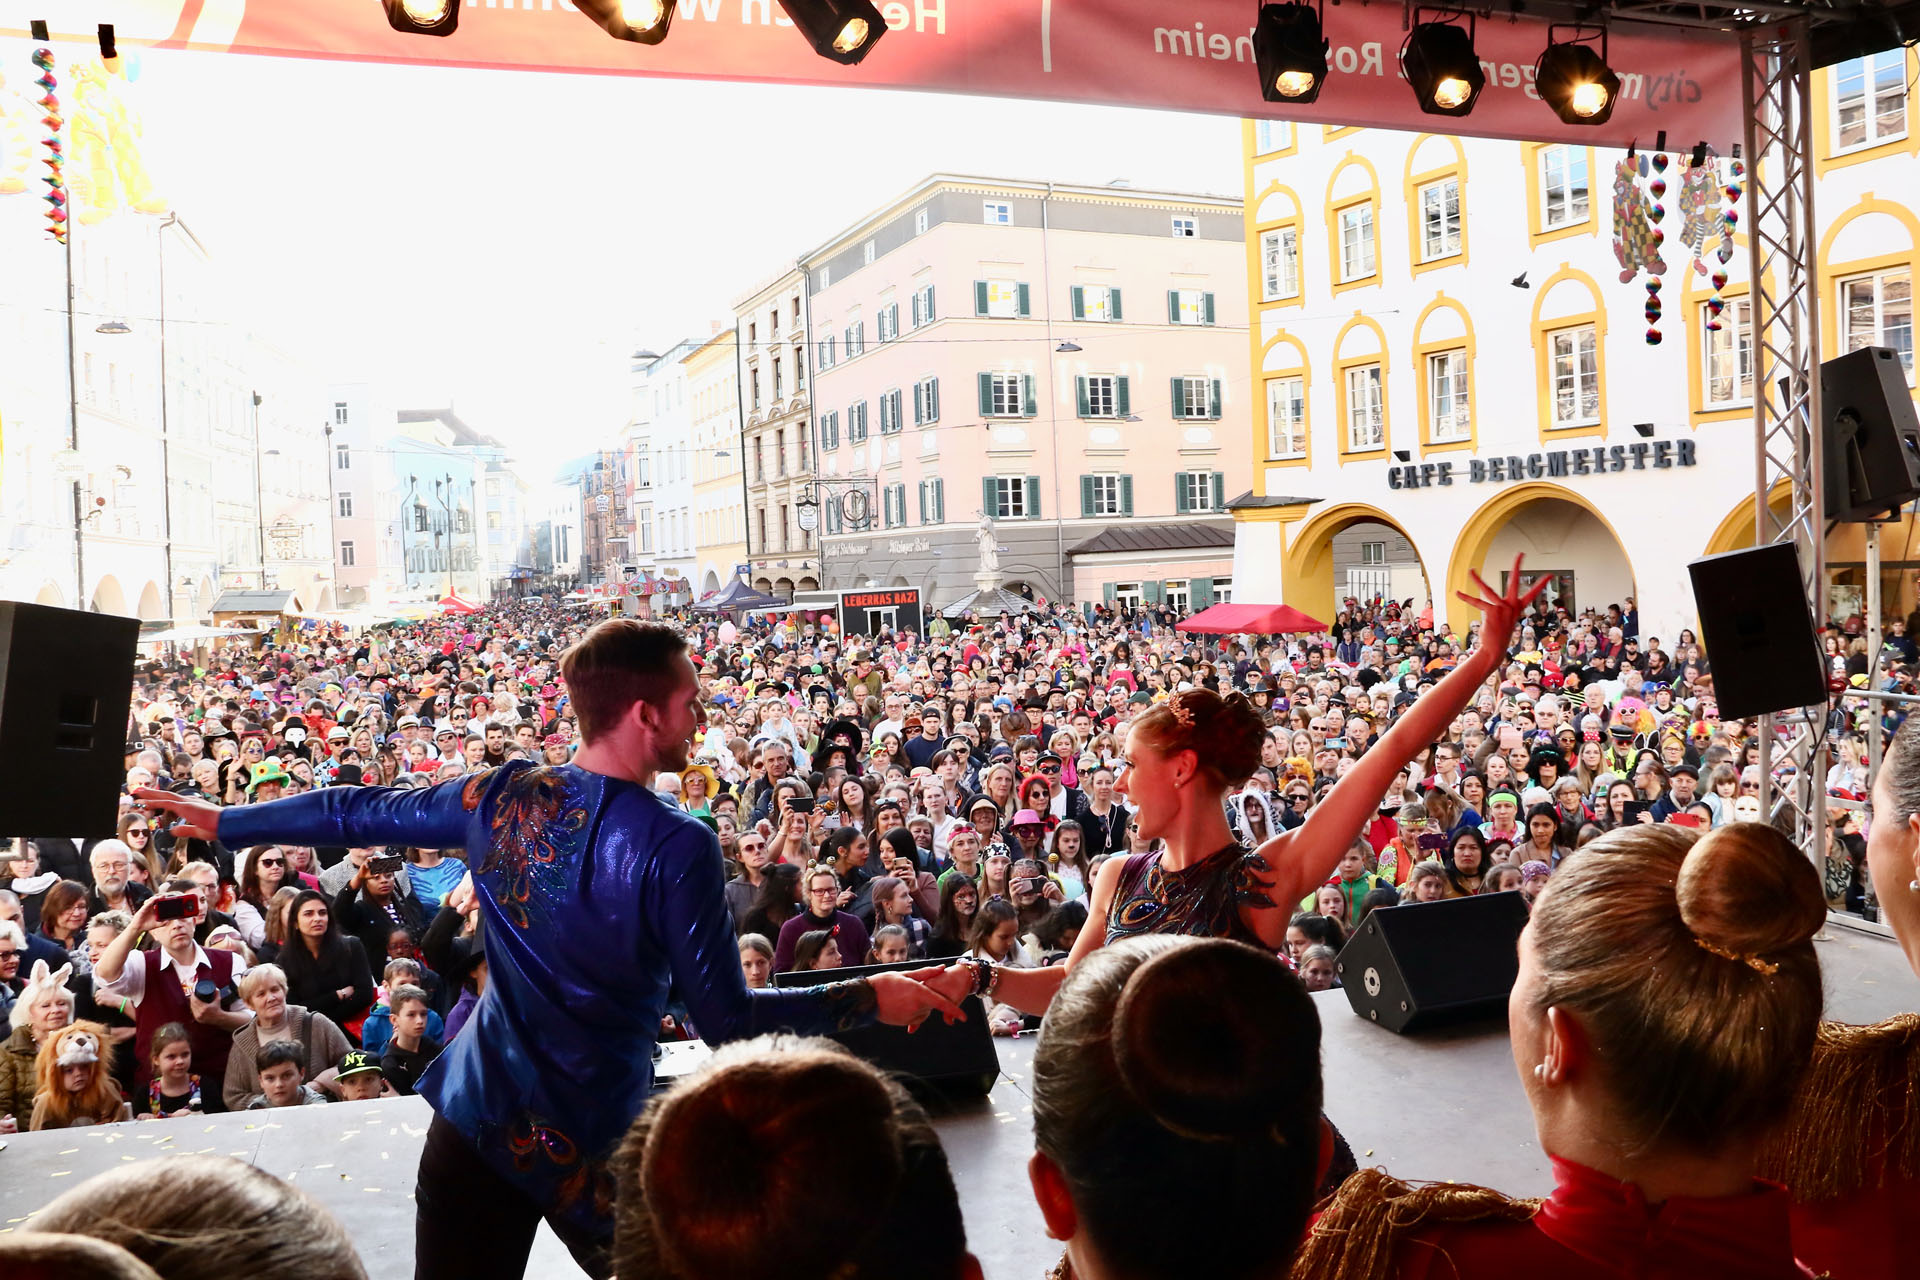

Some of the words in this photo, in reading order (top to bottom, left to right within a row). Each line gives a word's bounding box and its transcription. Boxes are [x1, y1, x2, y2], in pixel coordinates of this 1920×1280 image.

[1388, 462, 1452, 490] CAFE
[1469, 439, 1696, 483] BERGMEISTER
[844, 593, 892, 607] LEBERKAS
[893, 591, 917, 605] BAZI
[344, 1051, 367, 1067] NY
